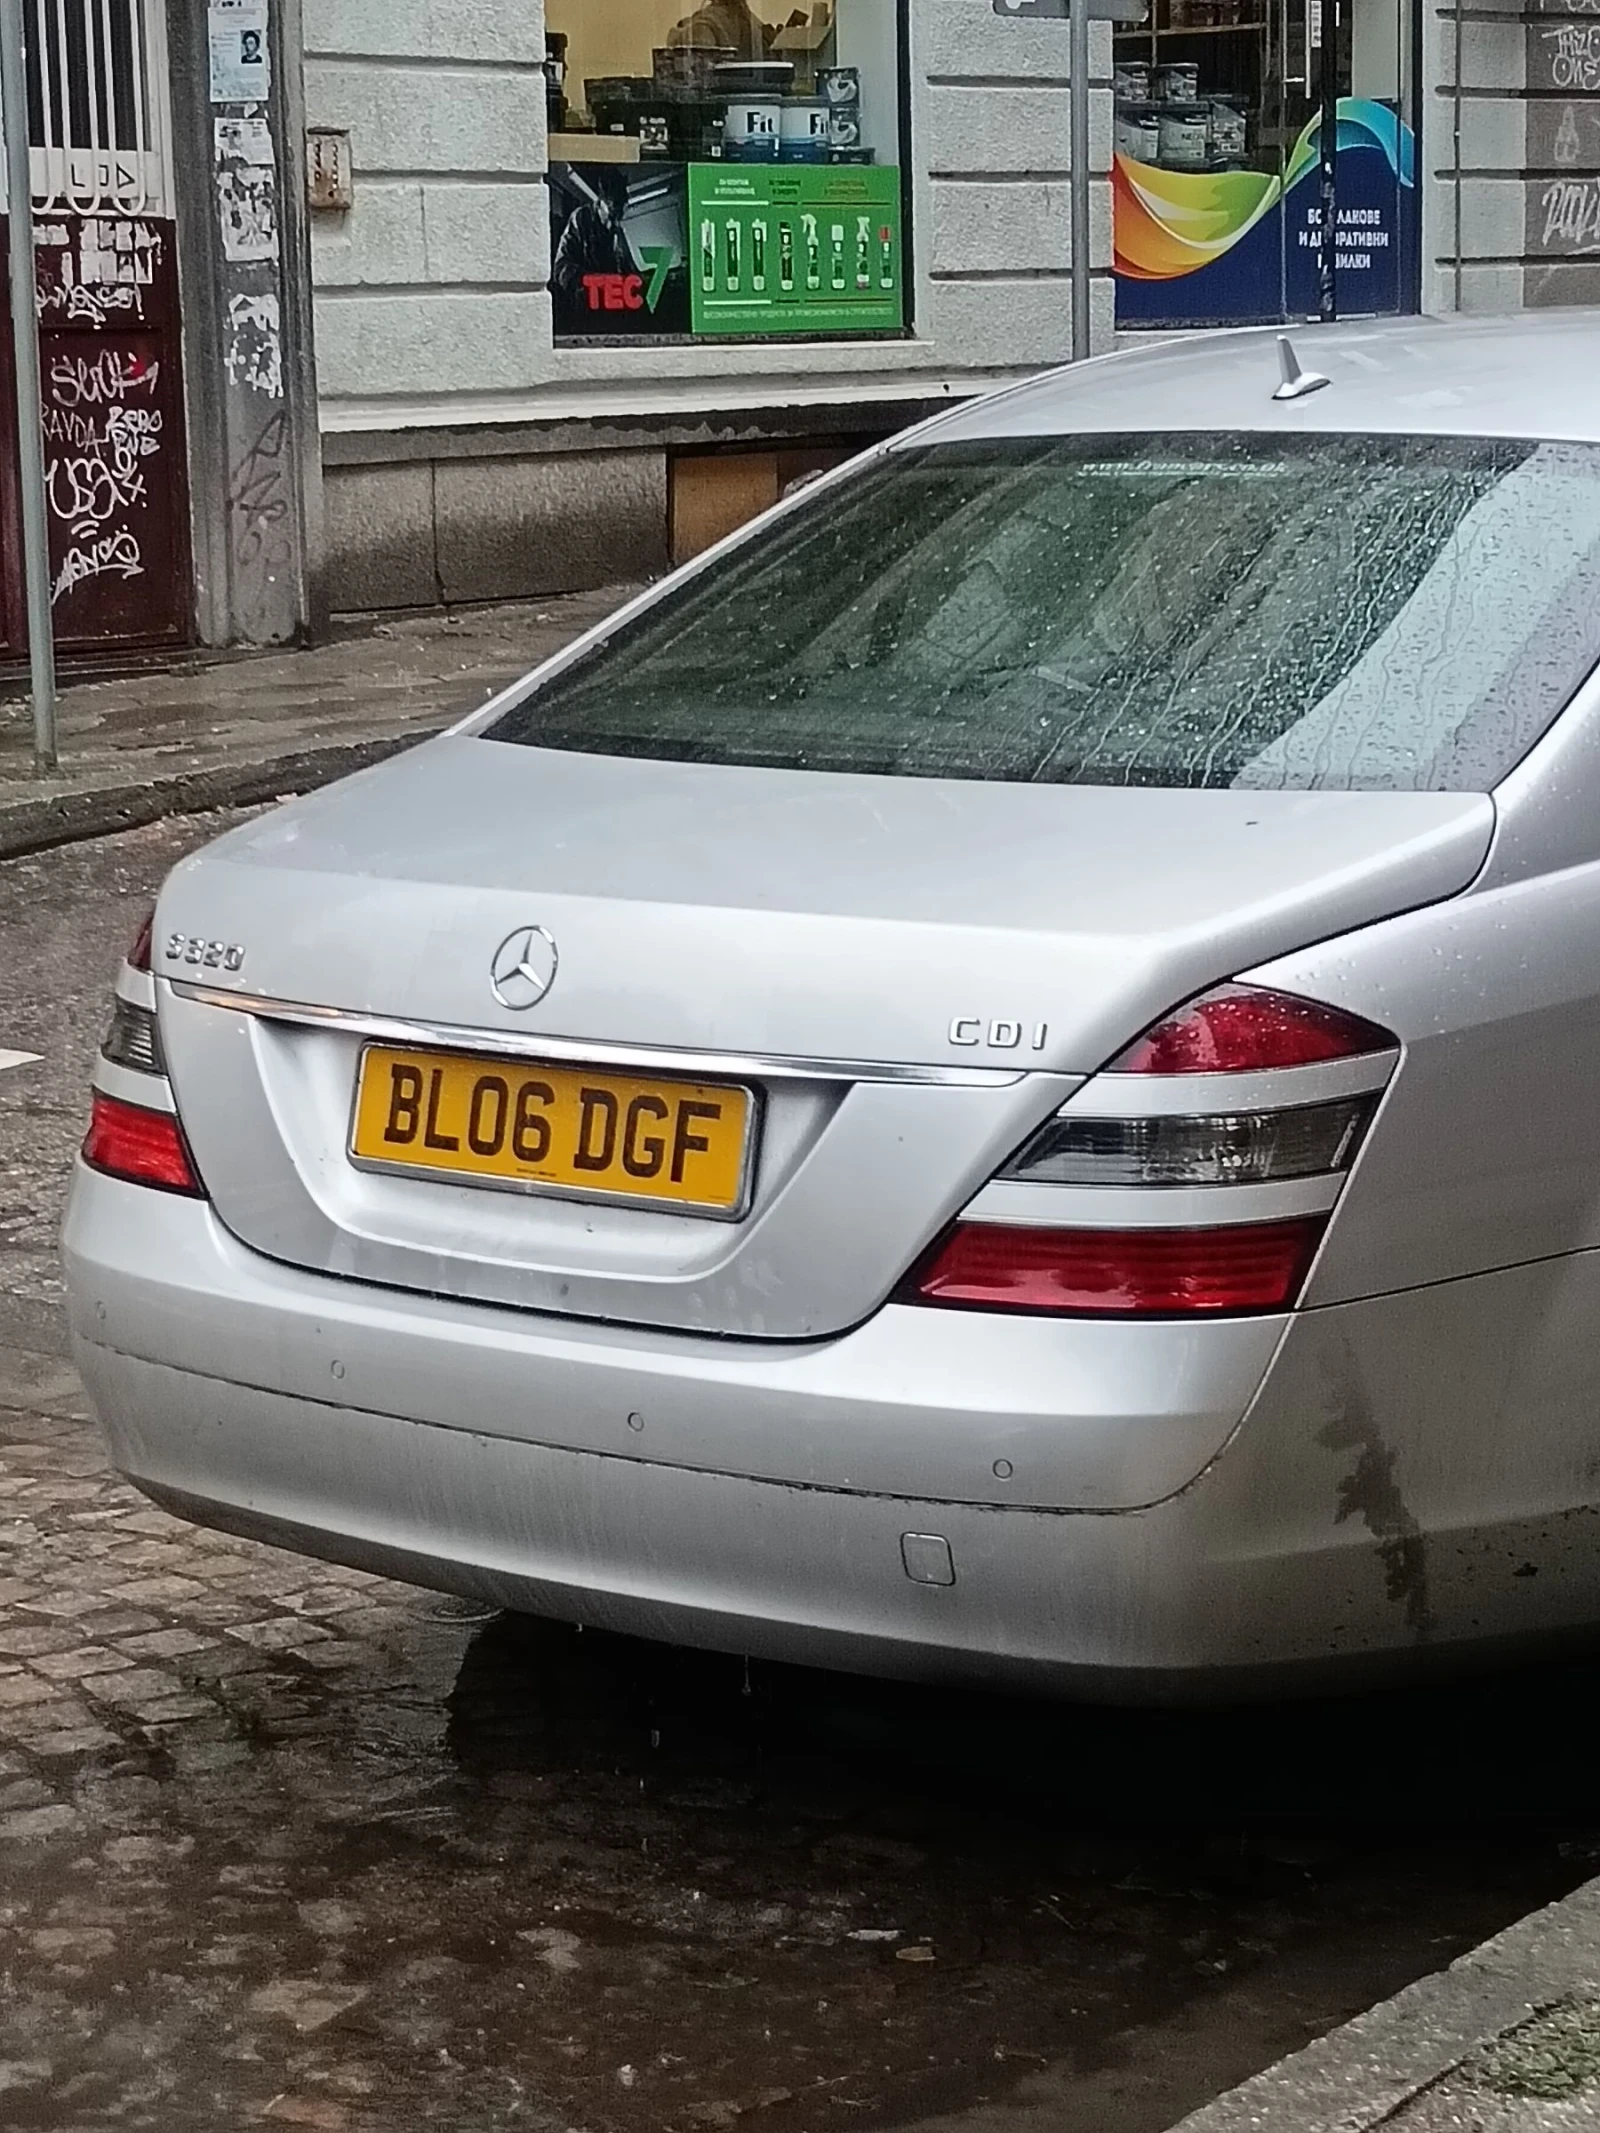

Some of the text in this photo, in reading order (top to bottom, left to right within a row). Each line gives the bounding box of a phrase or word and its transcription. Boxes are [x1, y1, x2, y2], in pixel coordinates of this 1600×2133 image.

[1336, 209, 1381, 225] ЛАКОВЕ
[1299, 231, 1308, 246] И
[165, 933, 246, 972] S320
[947, 1017, 1048, 1051] CDI
[383, 1062, 723, 1184] BL06 DGF
